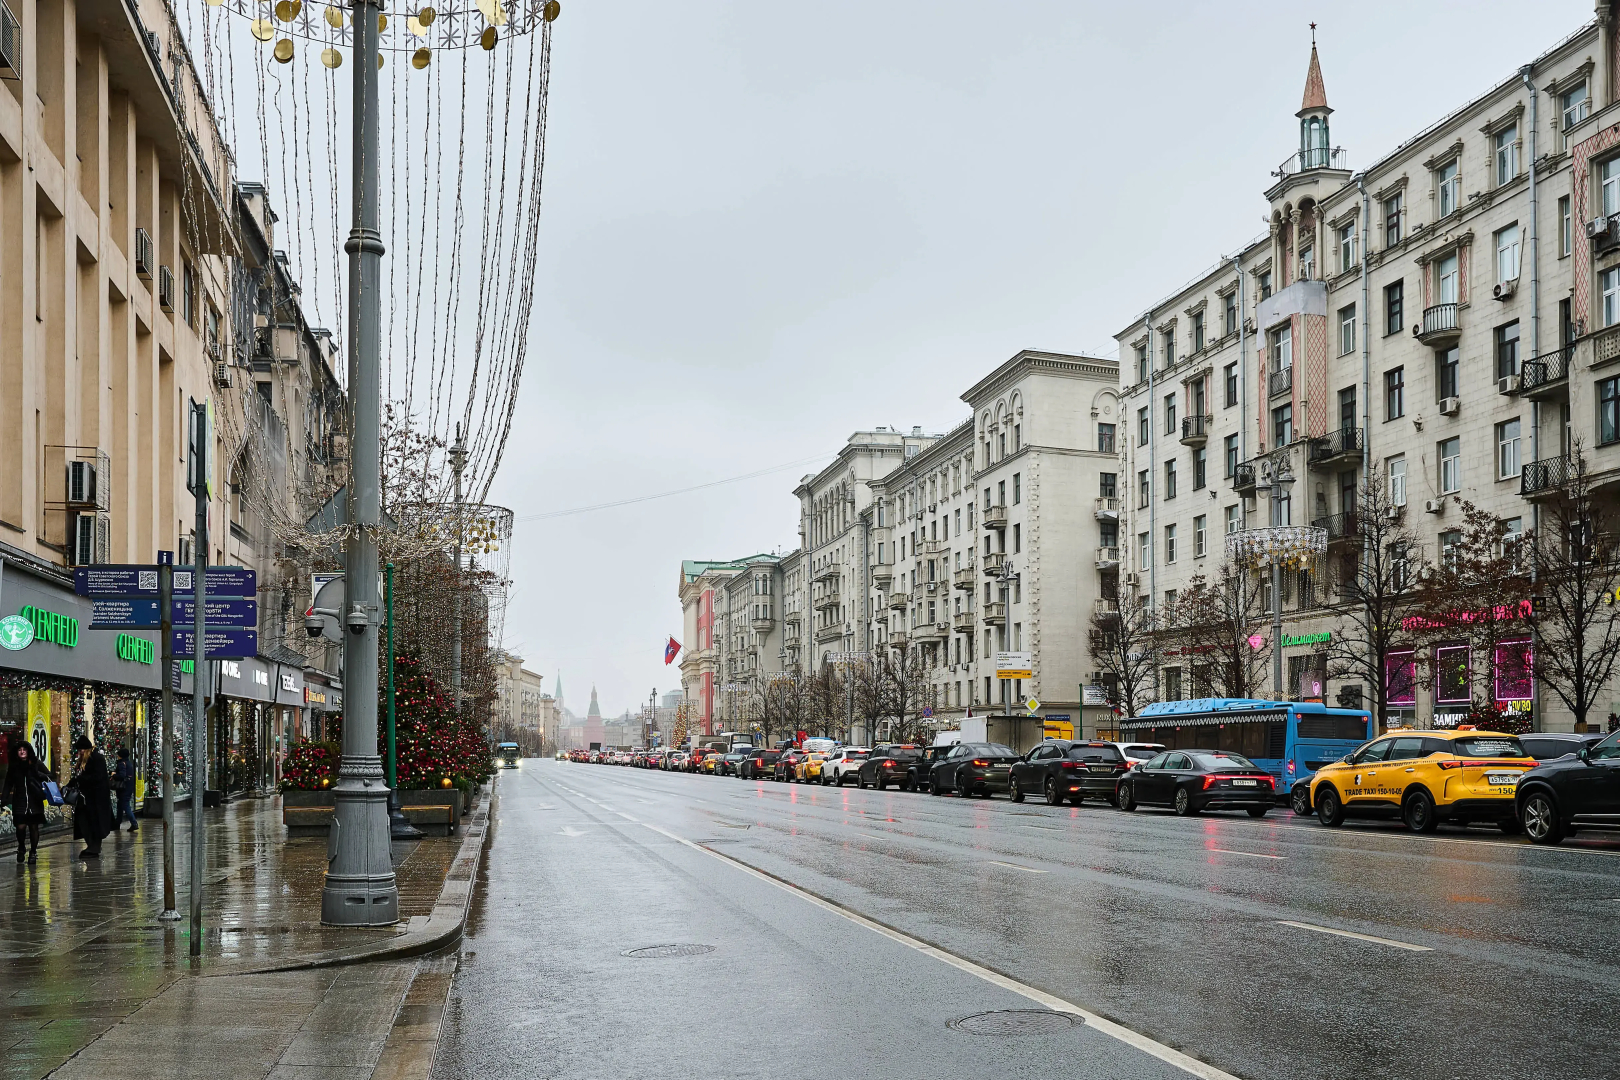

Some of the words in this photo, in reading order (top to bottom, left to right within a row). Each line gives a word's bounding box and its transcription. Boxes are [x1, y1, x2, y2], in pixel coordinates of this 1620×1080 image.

[118, 633, 154, 664] GLENFIELD
[1281, 632, 1330, 646] Делимаркет
[33, 729, 46, 762] 30
